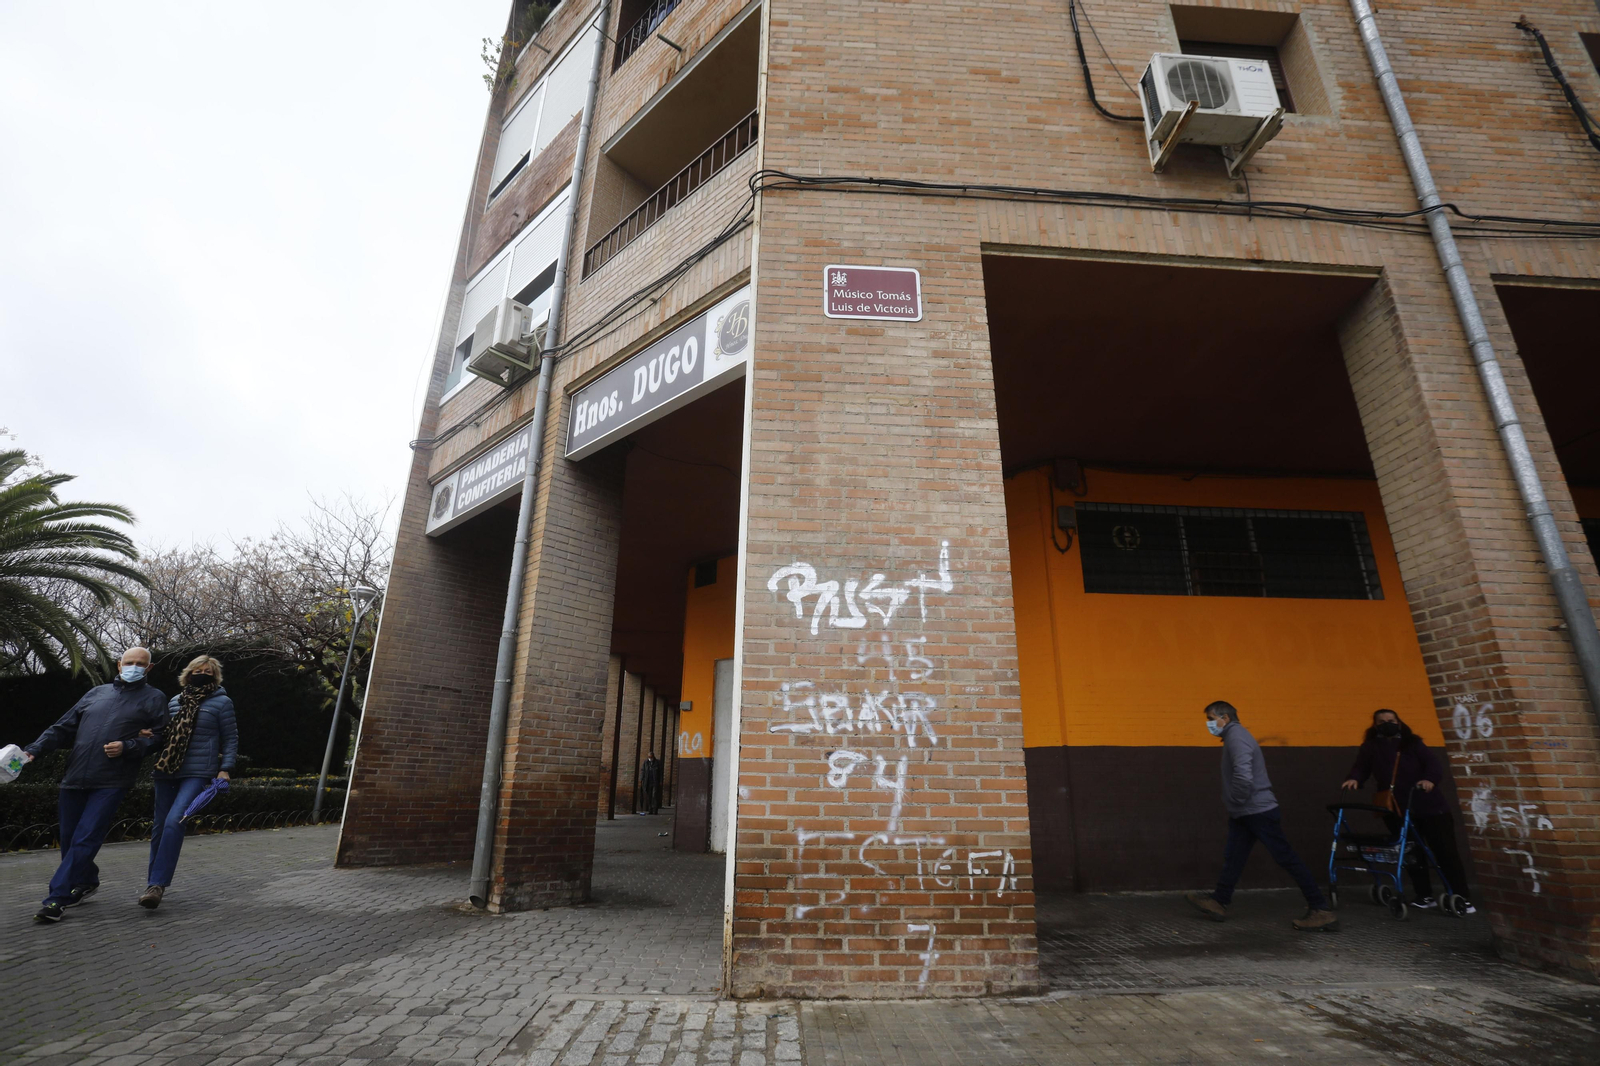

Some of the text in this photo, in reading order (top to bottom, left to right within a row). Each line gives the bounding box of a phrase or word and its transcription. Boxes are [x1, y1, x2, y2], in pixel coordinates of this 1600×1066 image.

[832, 302, 914, 314] Luis de Victoria
[833, 289, 911, 301] Músico Tomás
[573, 336, 698, 437] Hnos. DUGO
[457, 456, 526, 510] CONFITERÍA
[461, 433, 529, 489] PANADERÍA
[1453, 703, 1494, 740] 06
[907, 923, 940, 991] 7
